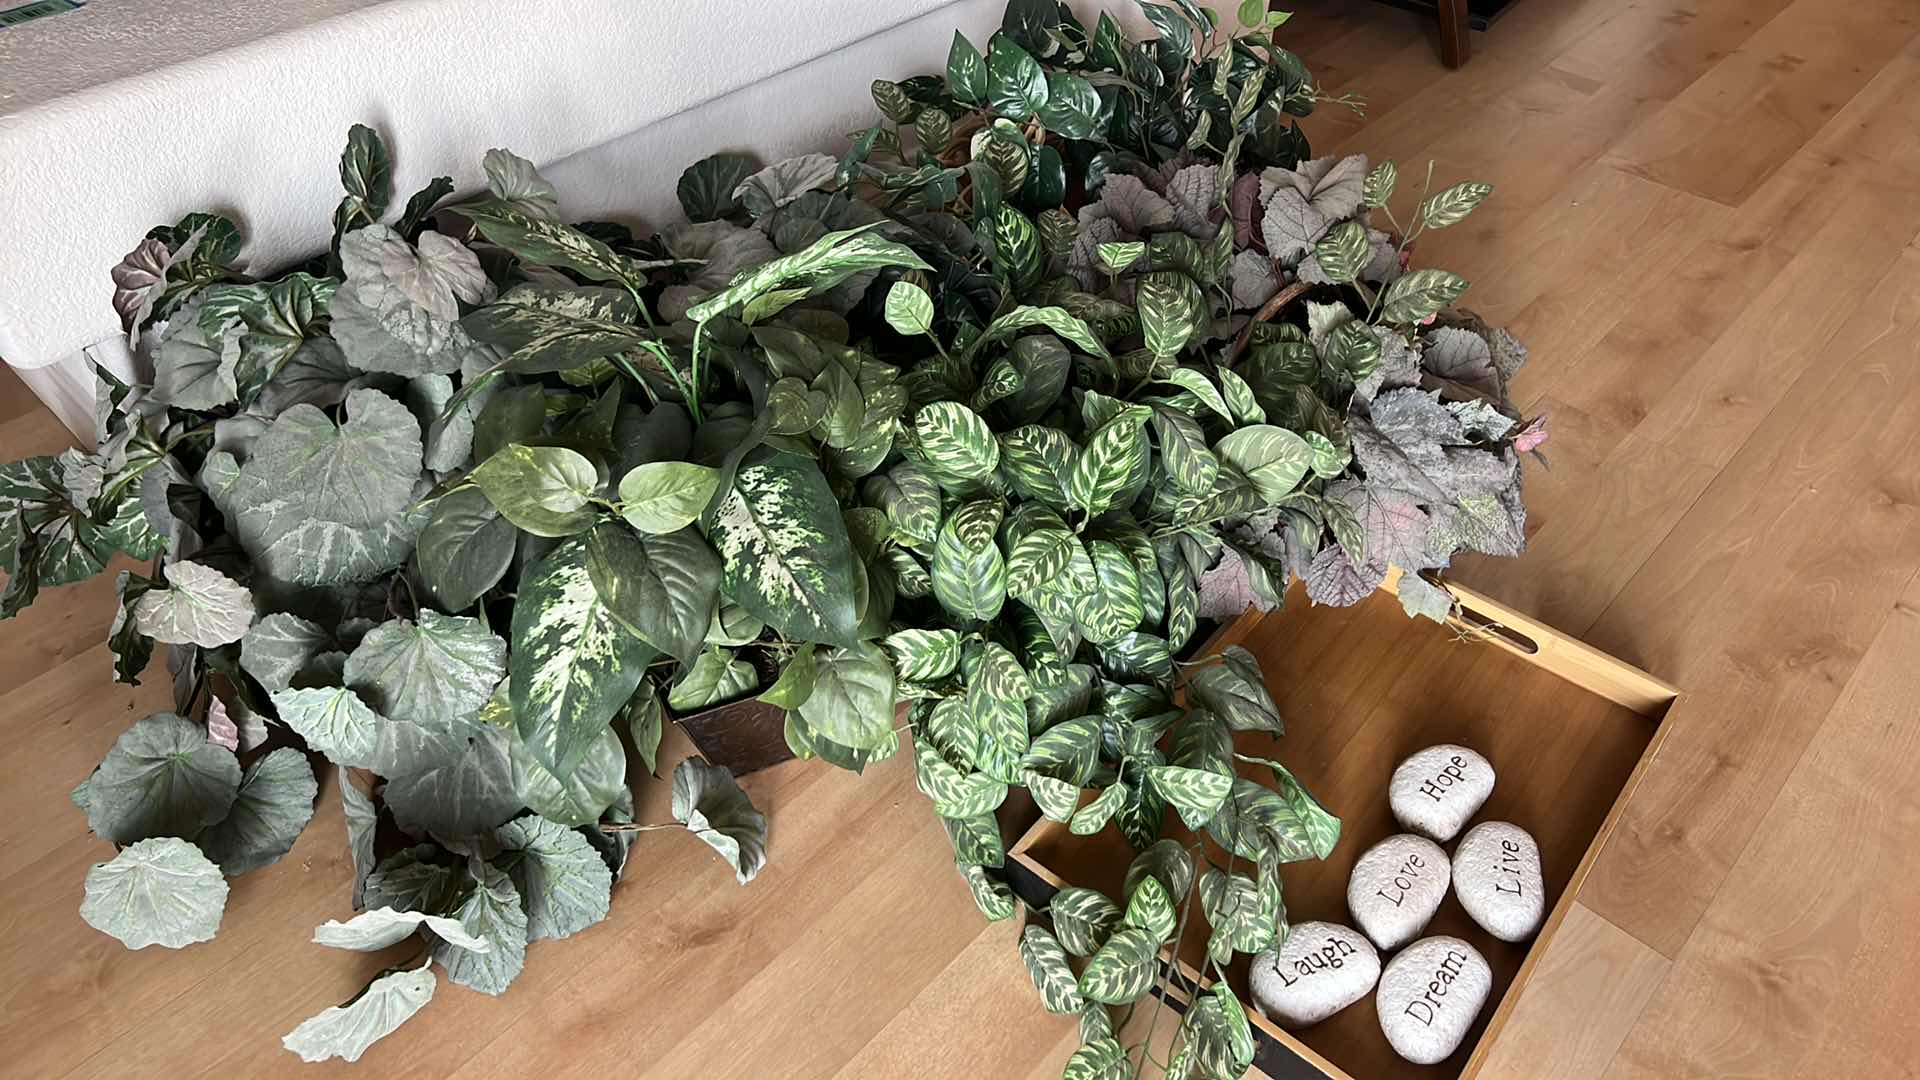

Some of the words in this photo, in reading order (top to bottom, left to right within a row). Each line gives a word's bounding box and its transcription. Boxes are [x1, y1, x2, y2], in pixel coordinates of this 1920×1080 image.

[1419, 755, 1468, 802] Hope
[1377, 852, 1426, 907] Love
[1493, 839, 1521, 897] Live
[1272, 937, 1357, 987] Laugh
[1404, 948, 1468, 1027] Dream
